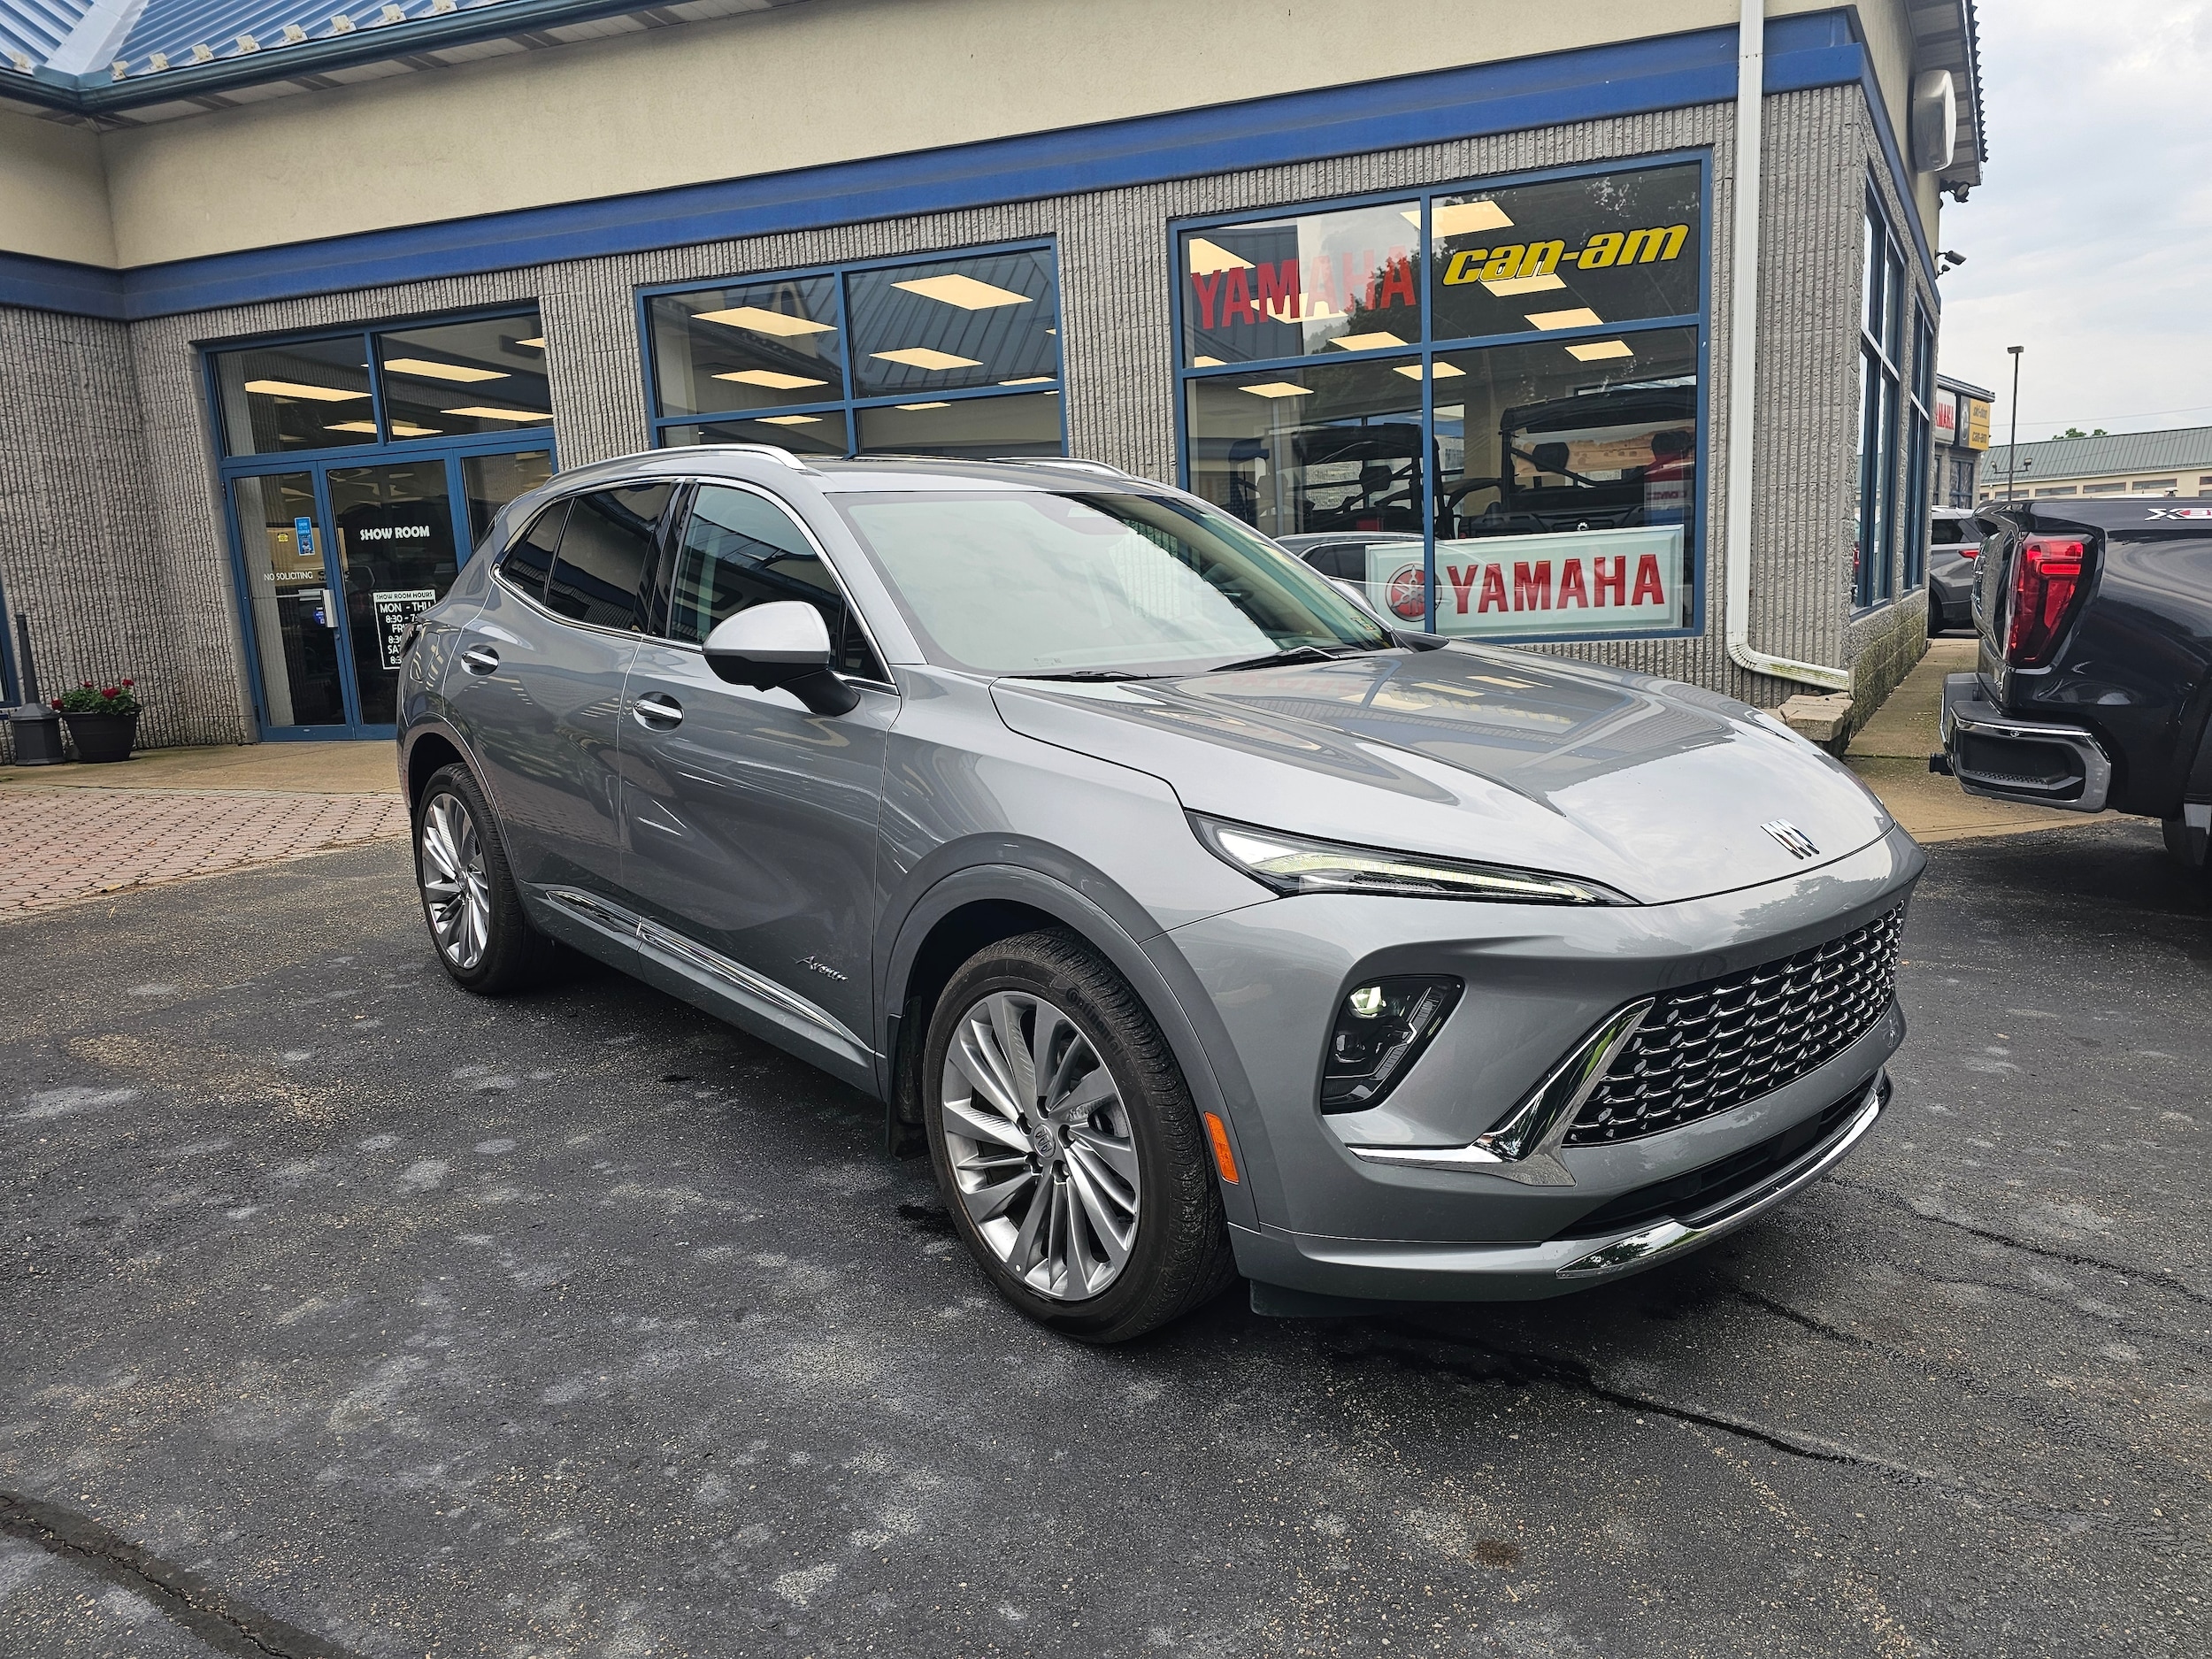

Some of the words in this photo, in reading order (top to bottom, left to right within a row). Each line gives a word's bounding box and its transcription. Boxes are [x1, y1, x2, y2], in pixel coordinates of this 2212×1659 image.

[1442, 224, 1690, 287] can-am
[1191, 245, 1417, 330] YAMAHA
[359, 527, 393, 541] SHOW
[394, 525, 431, 539] ROOM
[264, 572, 275, 581] NO
[275, 571, 313, 580] SOLICITING
[1446, 553, 1665, 615] YAMAHA
[379, 603, 403, 613] MON
[385, 614, 403, 623] 8:30
[388, 635, 402, 644] 8:3
[389, 656, 403, 664] 8:3
